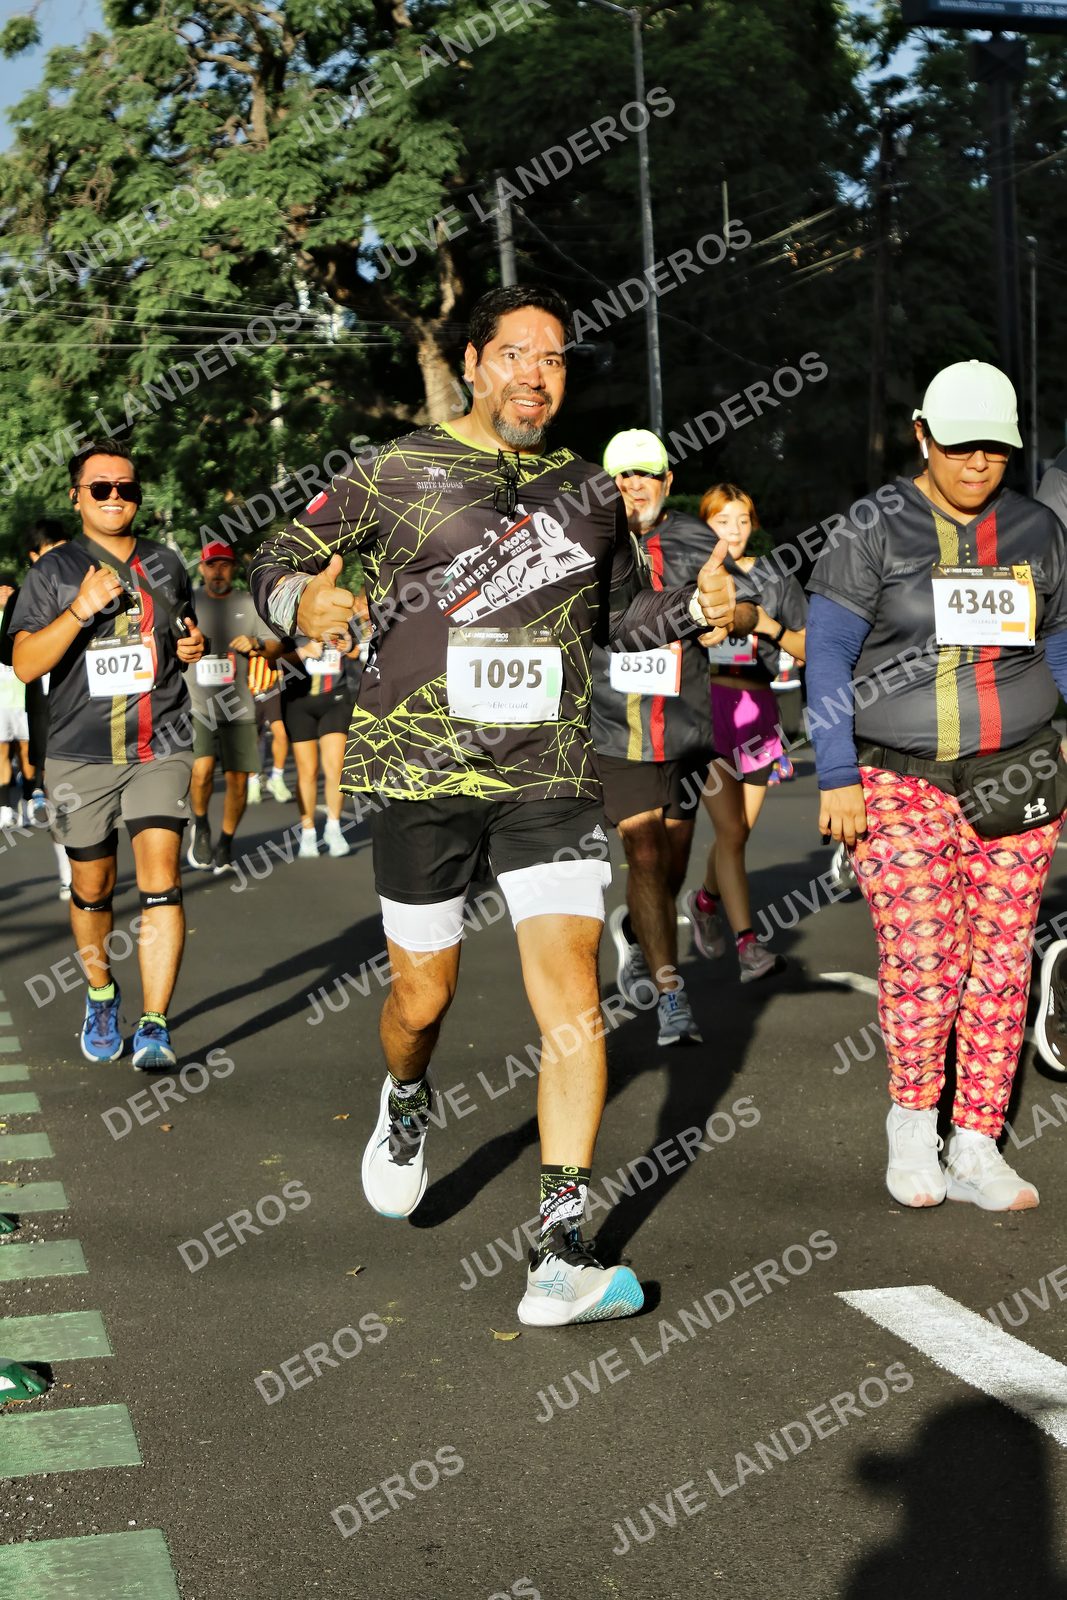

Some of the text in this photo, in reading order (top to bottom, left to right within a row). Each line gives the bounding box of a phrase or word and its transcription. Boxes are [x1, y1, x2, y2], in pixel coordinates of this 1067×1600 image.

[416, 481, 436, 489] SIETE
[510, 538, 532, 556] 2025
[438, 556, 498, 610] RUNNERS
[948, 589, 1015, 614] 4348
[96, 653, 143, 676] 8072
[200, 662, 230, 674] 11113
[470, 658, 542, 689] 1095
[620, 655, 666, 674] 8530
